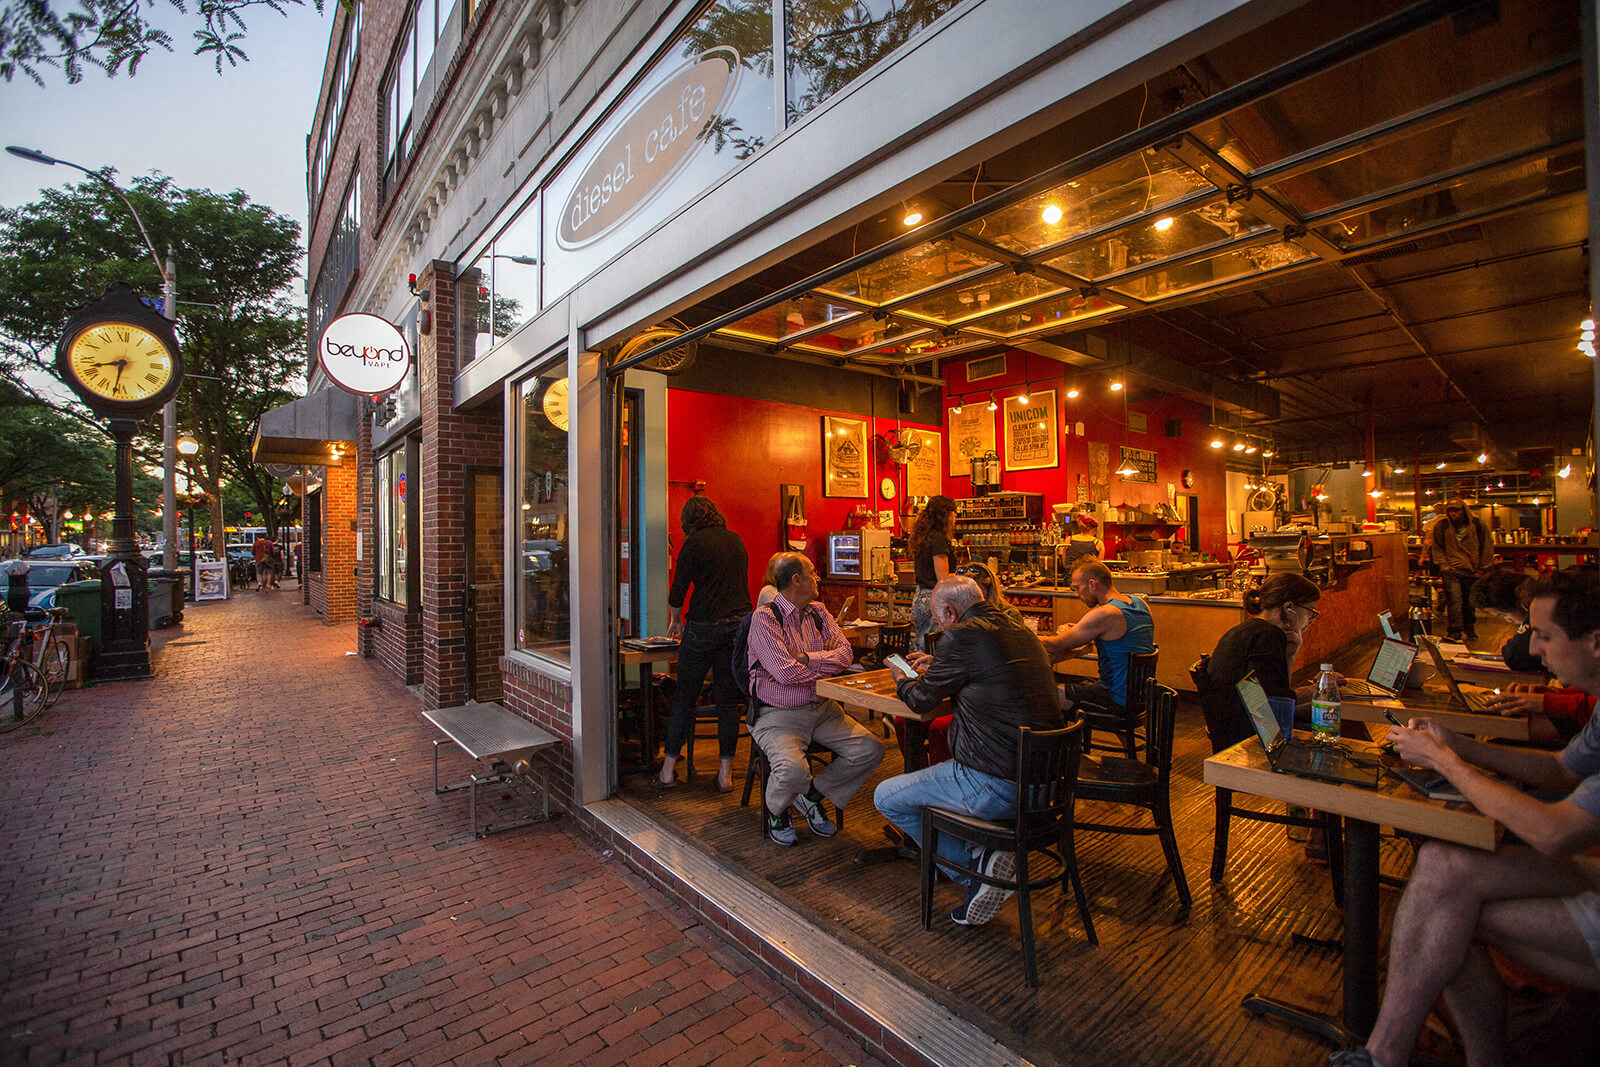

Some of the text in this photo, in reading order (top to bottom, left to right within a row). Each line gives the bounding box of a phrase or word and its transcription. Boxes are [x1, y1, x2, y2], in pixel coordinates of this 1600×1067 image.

[571, 83, 707, 231] diesel cafe
[326, 337, 403, 365] beyond
[1010, 406, 1048, 423] UNICOM
